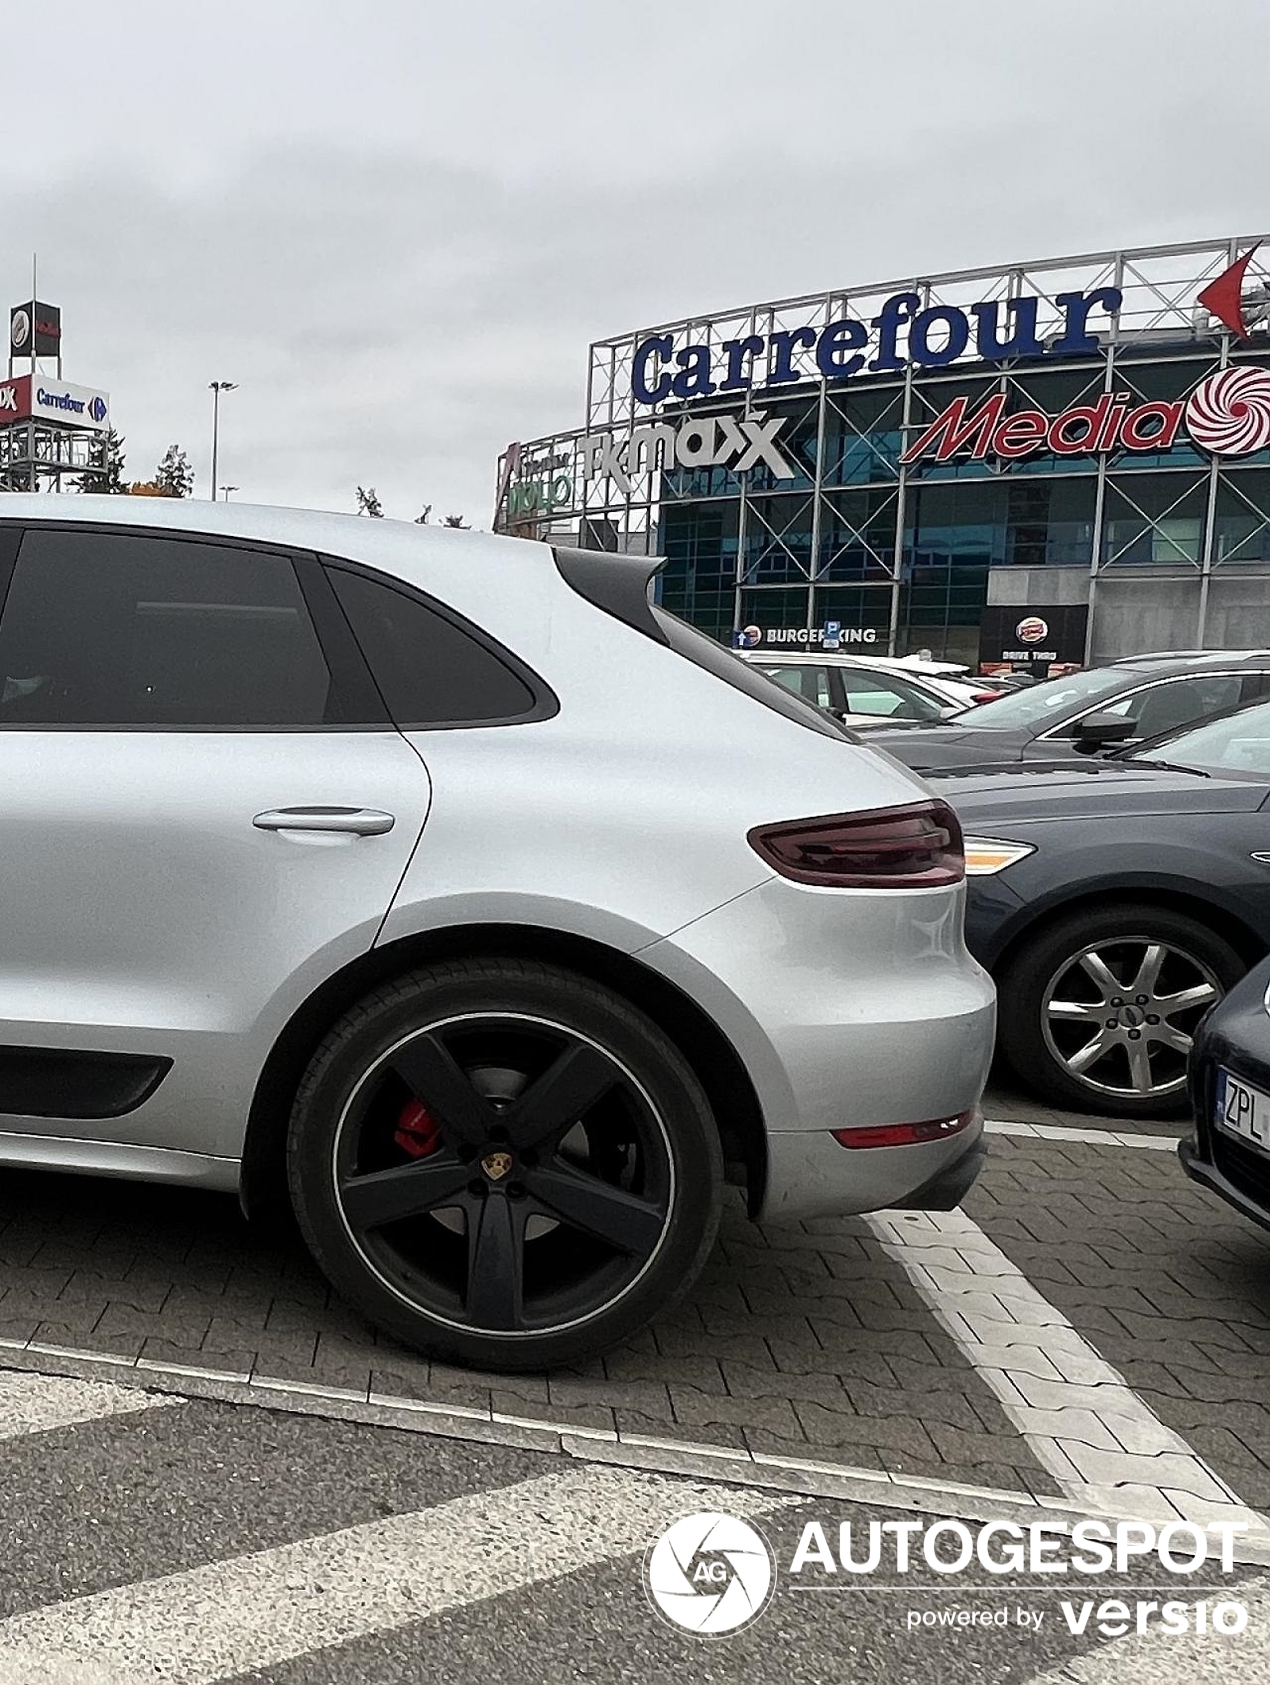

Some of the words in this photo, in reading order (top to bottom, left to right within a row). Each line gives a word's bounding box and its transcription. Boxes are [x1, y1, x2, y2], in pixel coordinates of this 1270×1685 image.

[630, 285, 1124, 405] Carrefour
[36, 387, 86, 414] Carrefour
[898, 391, 1187, 464] Media
[1225, 1080, 1263, 1142] ZPL
